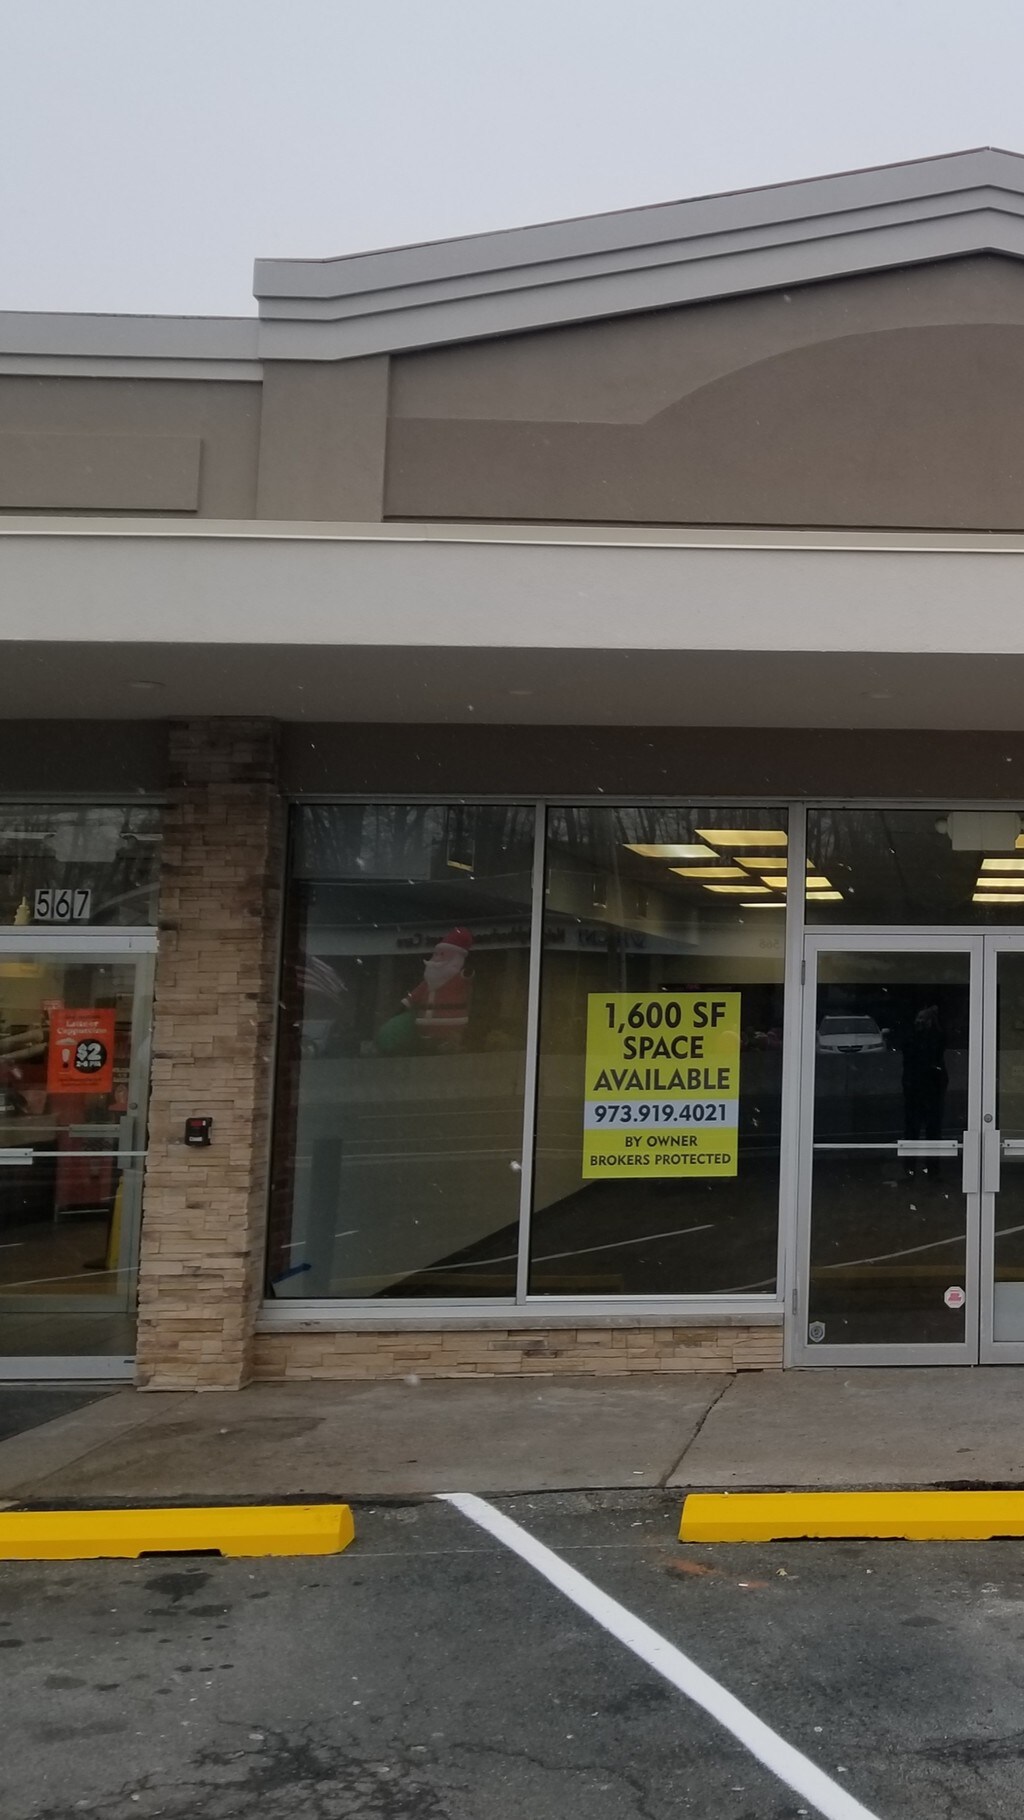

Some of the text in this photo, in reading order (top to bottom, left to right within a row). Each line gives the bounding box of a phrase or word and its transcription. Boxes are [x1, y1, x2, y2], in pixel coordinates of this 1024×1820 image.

[36, 890, 89, 918] 567
[605, 1001, 727, 1034] 1,600 SF
[76, 1043, 102, 1061] $2
[623, 1035, 704, 1060] SPACE
[593, 1067, 731, 1092] AVAILABLE
[594, 1103, 726, 1123] 973.919.4021
[625, 1135, 698, 1148] BY OWNER
[590, 1153, 731, 1166] BROKERS PROTECTED
